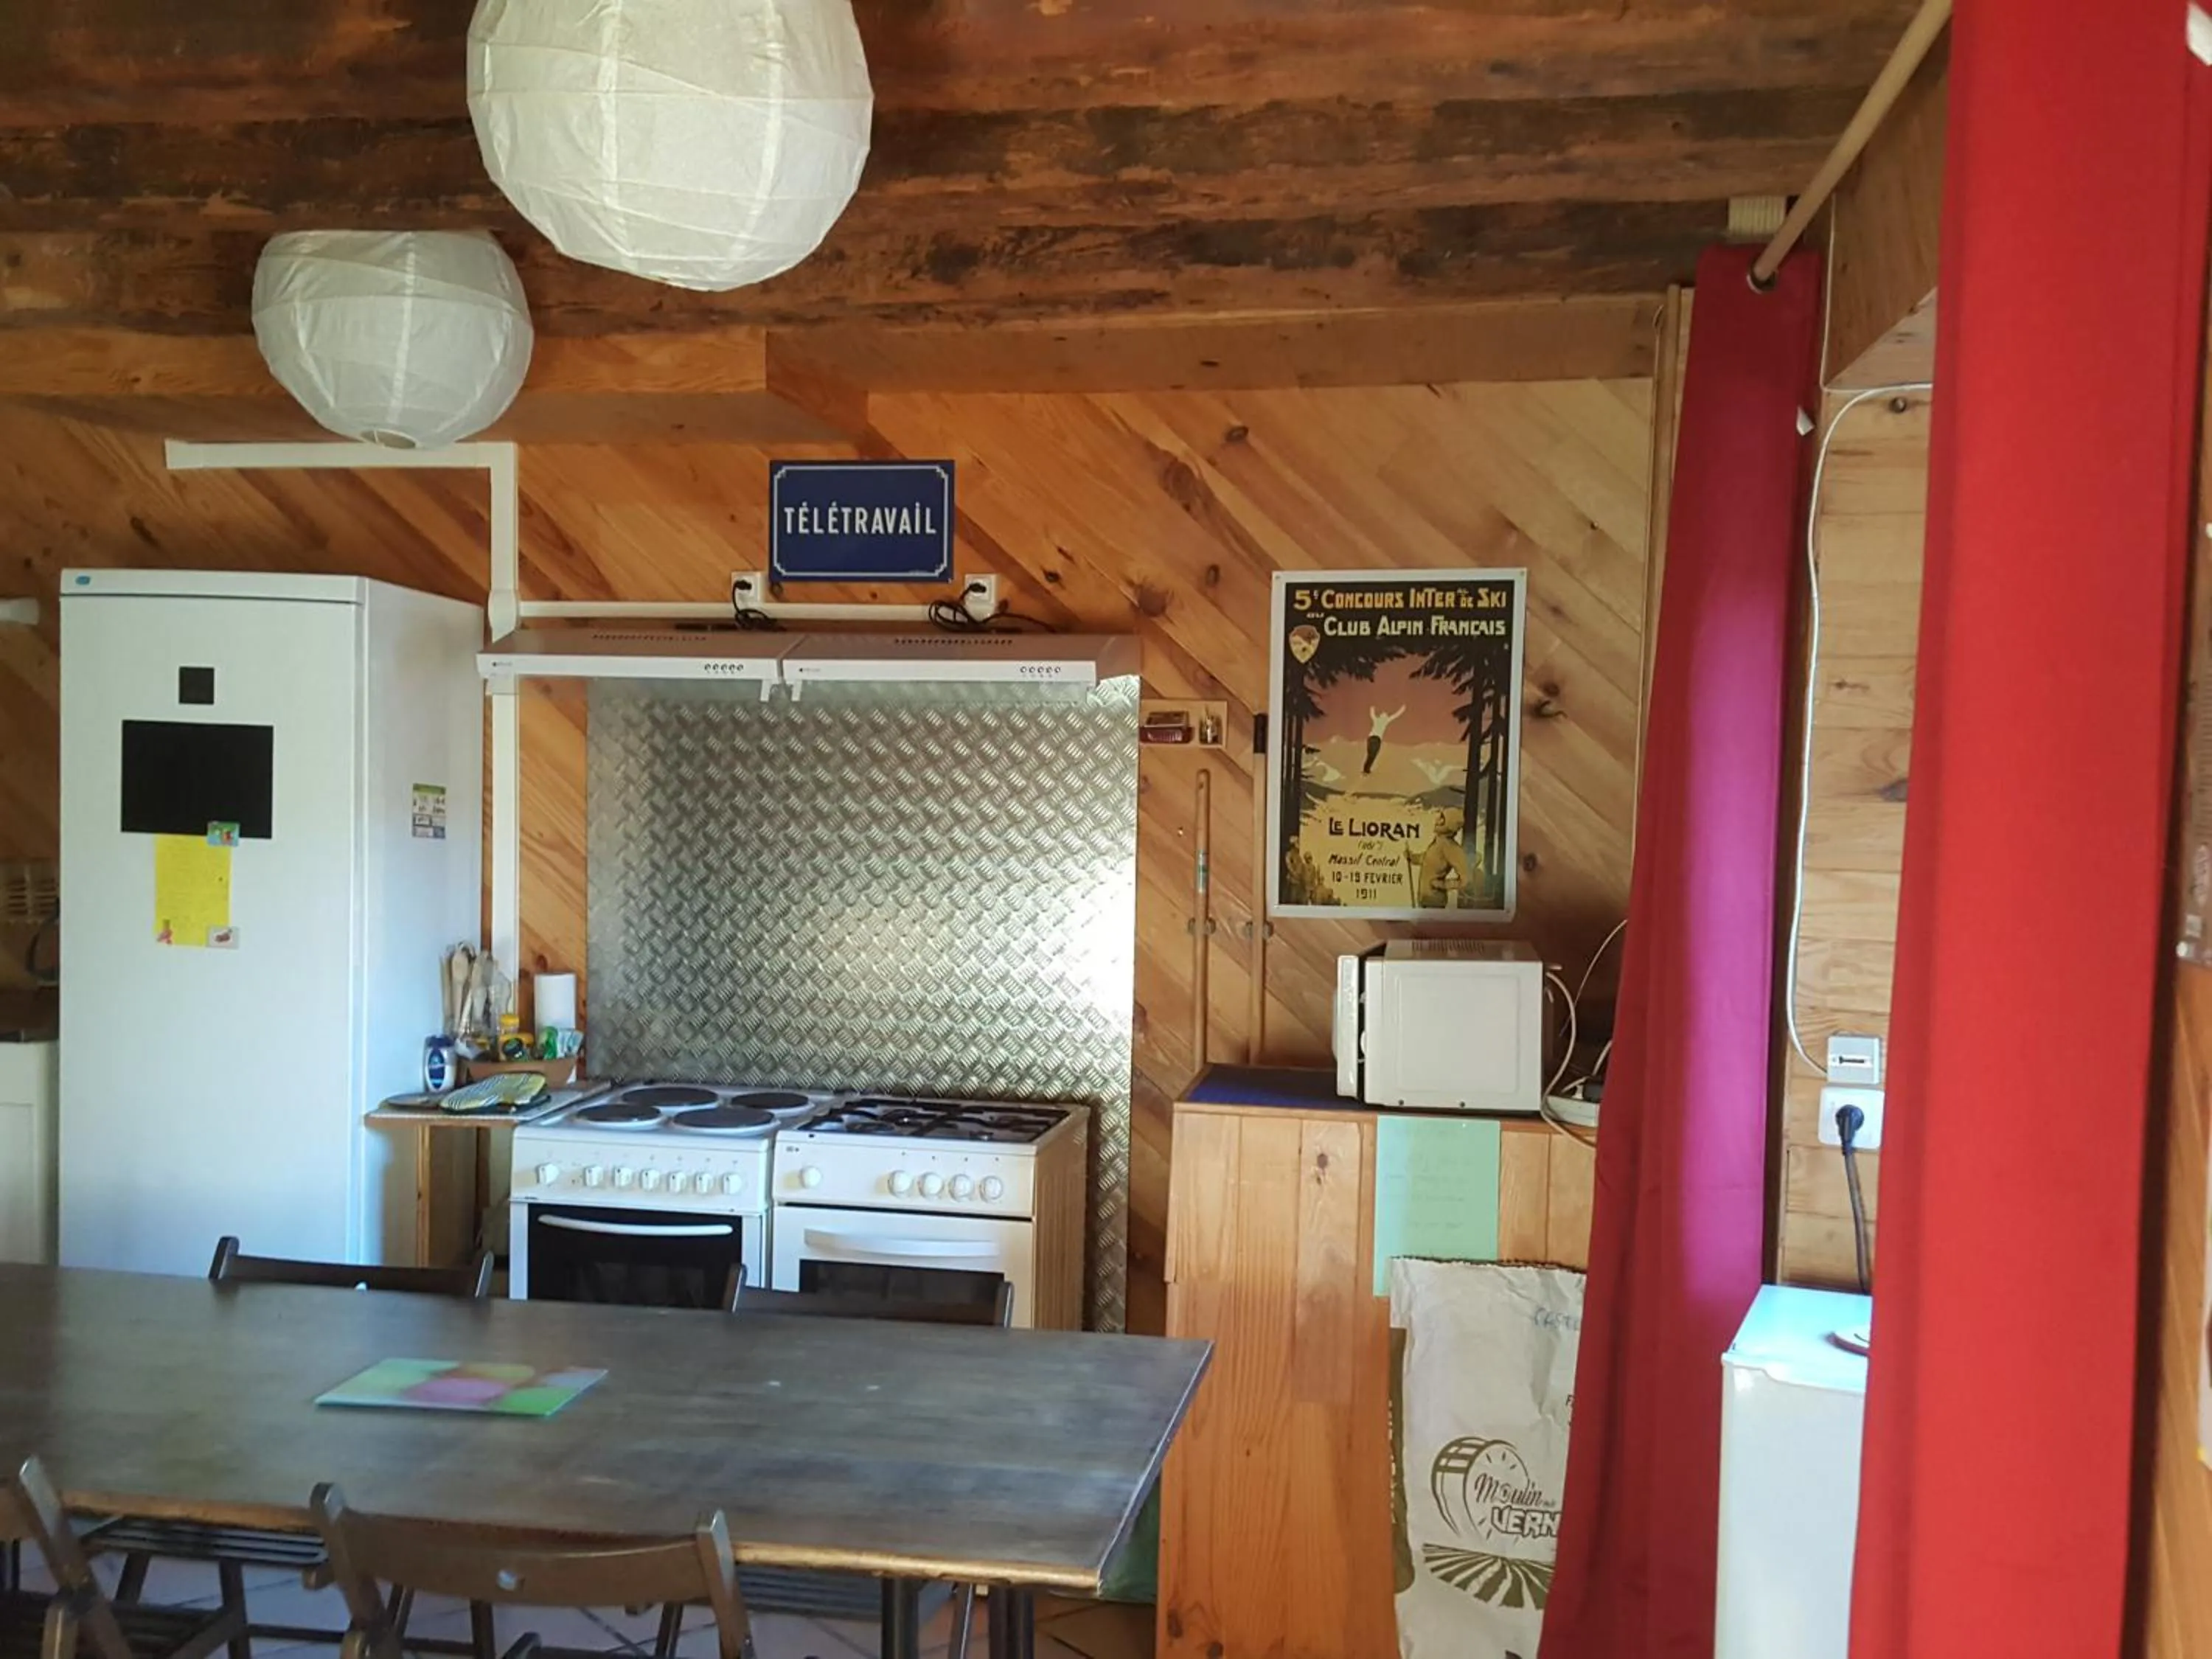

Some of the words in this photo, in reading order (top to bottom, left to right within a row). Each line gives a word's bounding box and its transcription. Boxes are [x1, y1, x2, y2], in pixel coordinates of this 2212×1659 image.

[1321, 588, 1404, 609] CONCOURS
[1477, 587, 1507, 608] SKI
[1323, 616, 1371, 636] CLUB
[1376, 615, 1424, 636] ALPIN
[1329, 816, 1343, 836] LE
[1349, 818, 1419, 841] LIORAN
[1328, 852, 1363, 865] Massif
[1366, 855, 1400, 867] Central
[1356, 888, 1377, 900] 1911
[1474, 1472, 1543, 1506] Moulin
